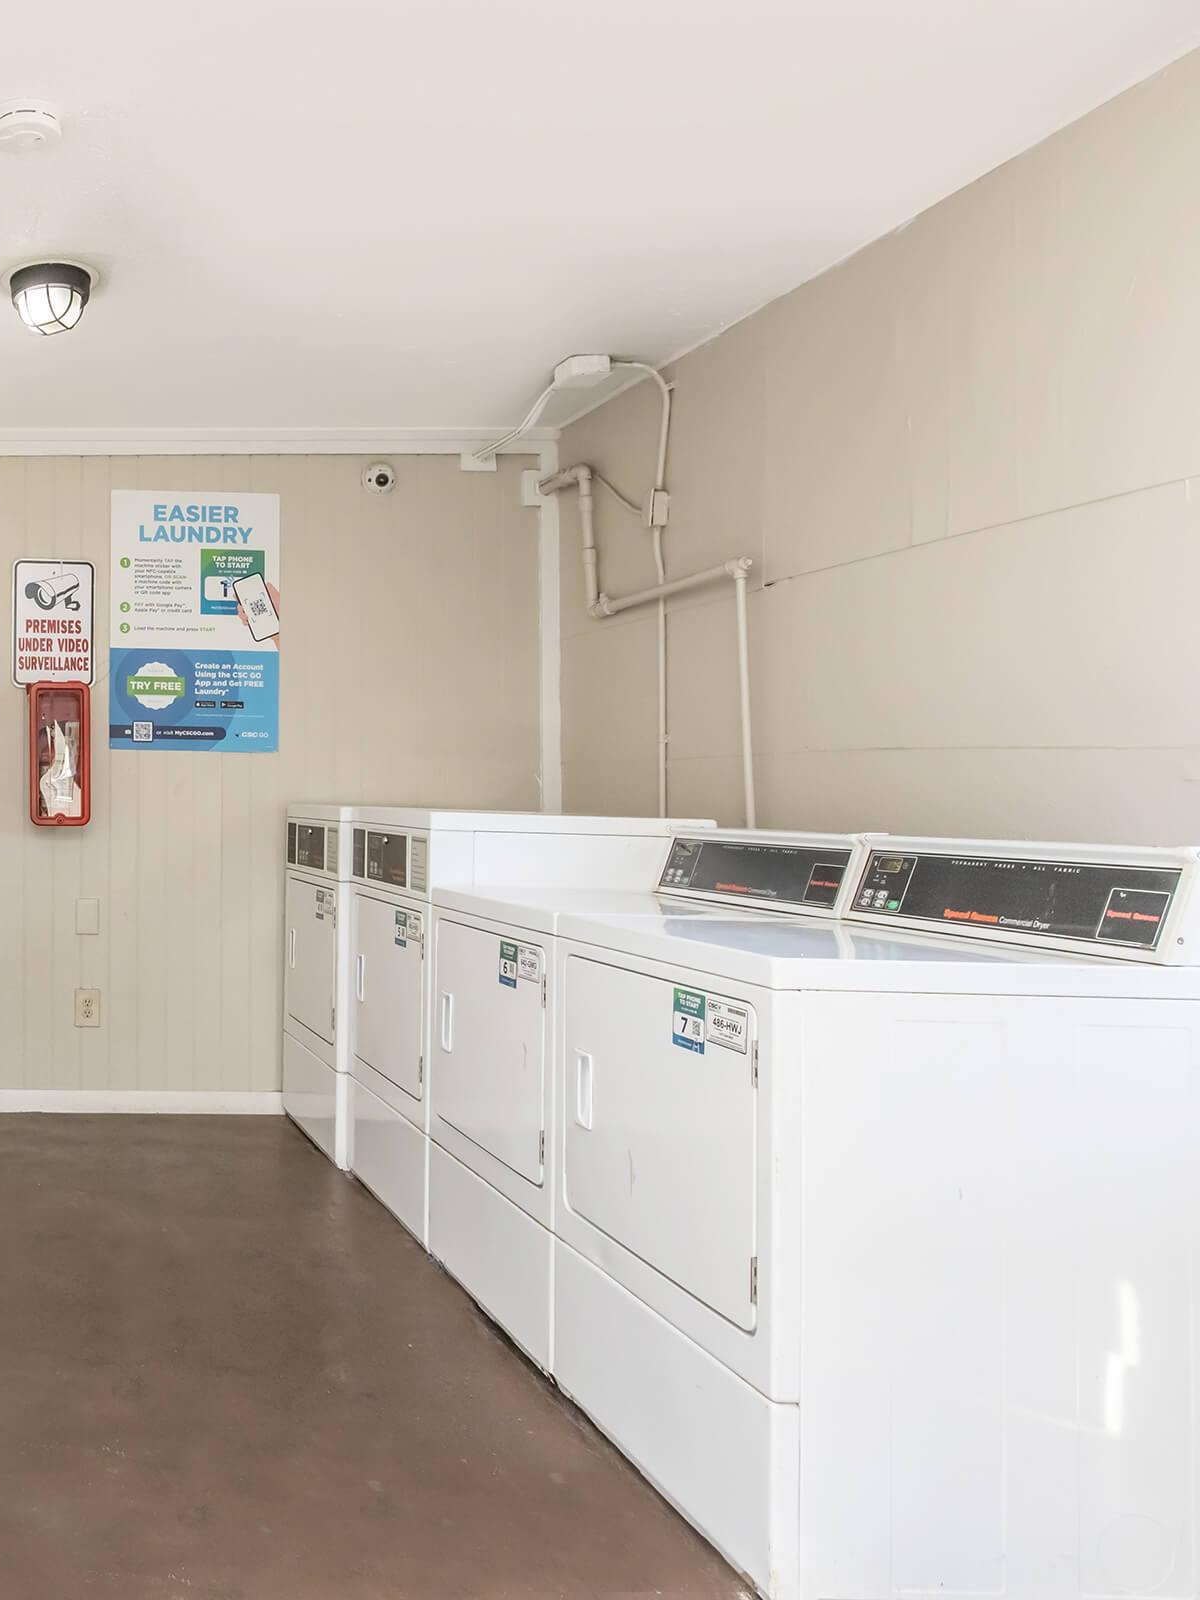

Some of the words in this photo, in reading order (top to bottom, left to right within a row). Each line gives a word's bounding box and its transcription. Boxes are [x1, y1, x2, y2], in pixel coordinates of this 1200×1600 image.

[153, 504, 239, 523] EASIER
[139, 525, 253, 544] LAUNDRY
[228, 556, 254, 564] PHONE
[25, 619, 82, 634] PREMISES
[18, 638, 53, 652] UNDER
[57, 639, 89, 653] VIDEO
[18, 655, 89, 671] SURVEILLANCE
[195, 671, 217, 679] Using
[130, 681, 151, 690] TRY
[154, 682, 182, 691] FREE
[999, 915, 1033, 928] Commercial
[1032, 919, 1050, 930] Dryer
[503, 961, 508, 974] 6
[681, 1017, 689, 1033] 7
